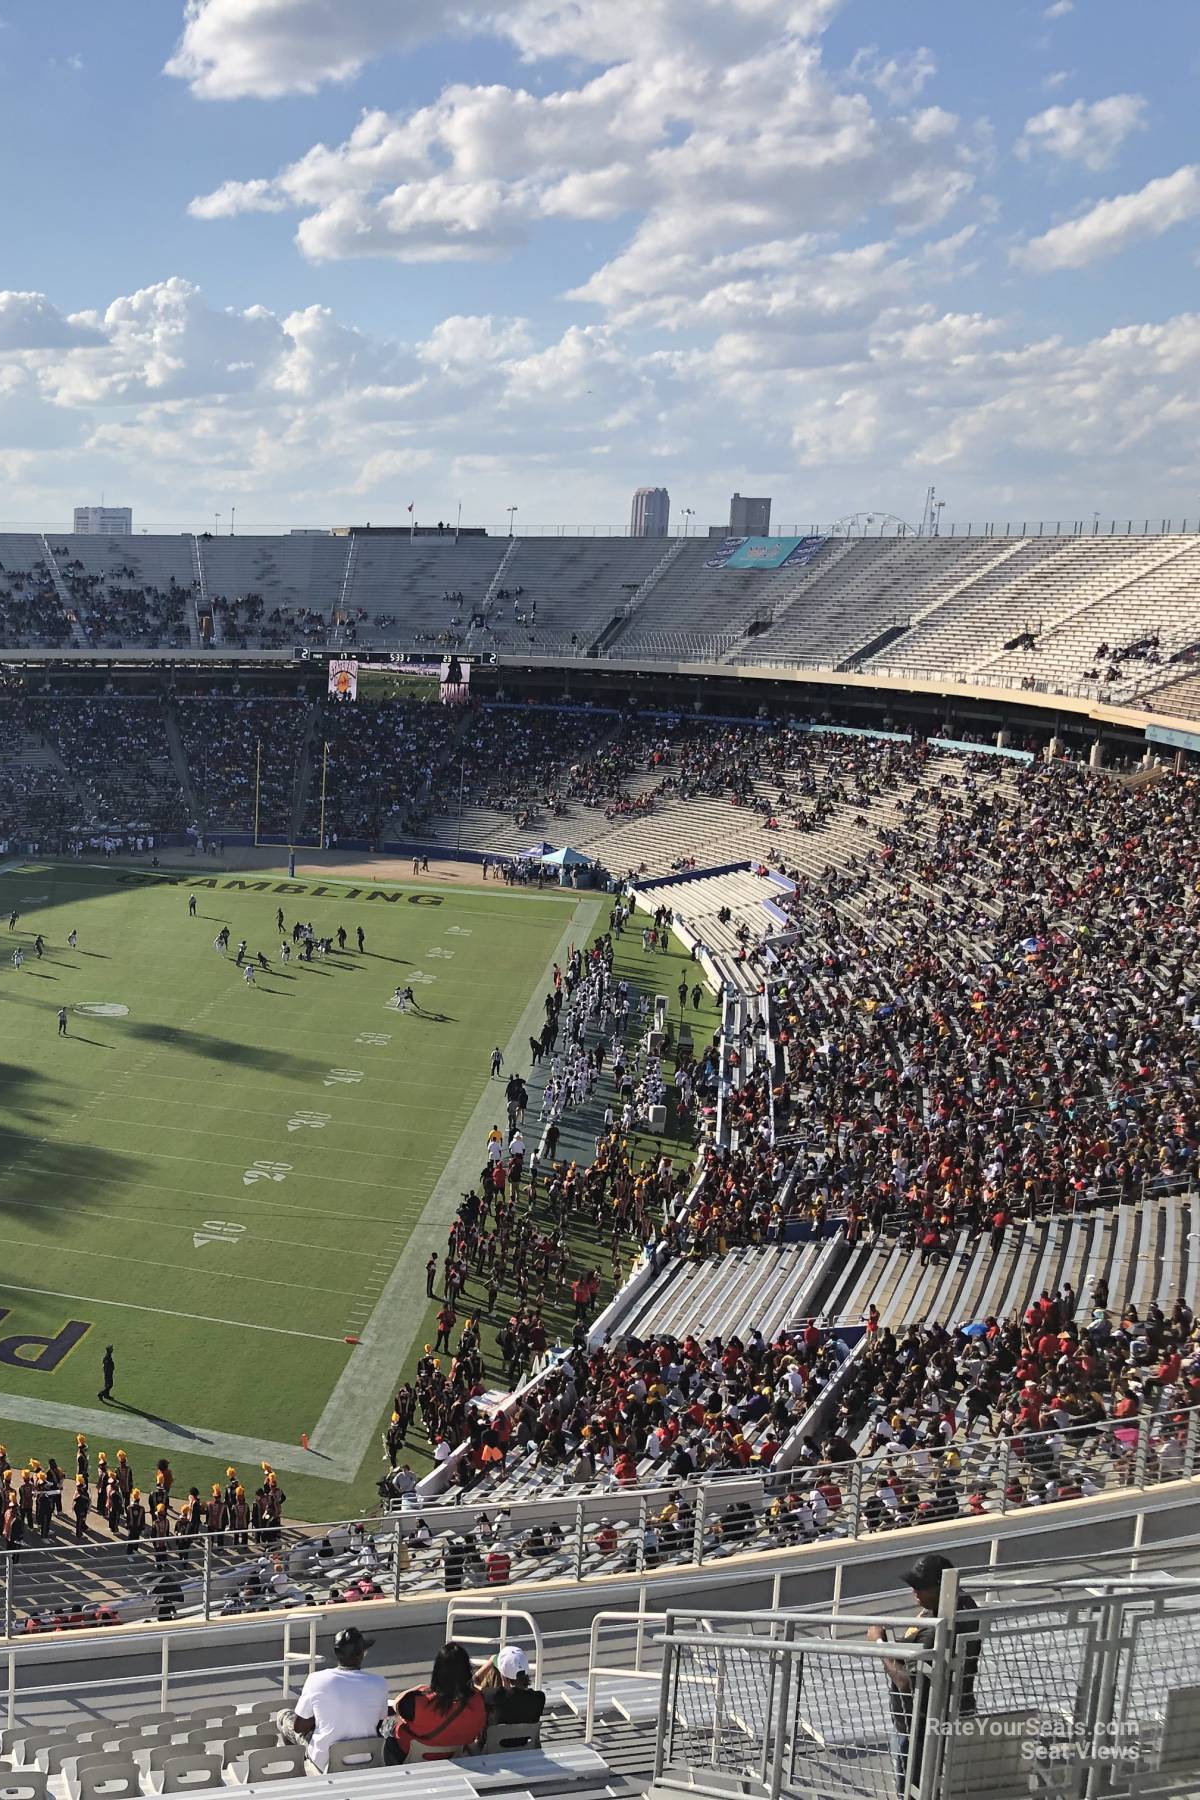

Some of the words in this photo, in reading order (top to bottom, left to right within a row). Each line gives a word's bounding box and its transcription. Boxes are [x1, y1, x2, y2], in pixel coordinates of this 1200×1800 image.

[115, 874, 446, 906] GRAMBLING
[244, 1160, 294, 1182] 20
[192, 1220, 247, 1245] 10
